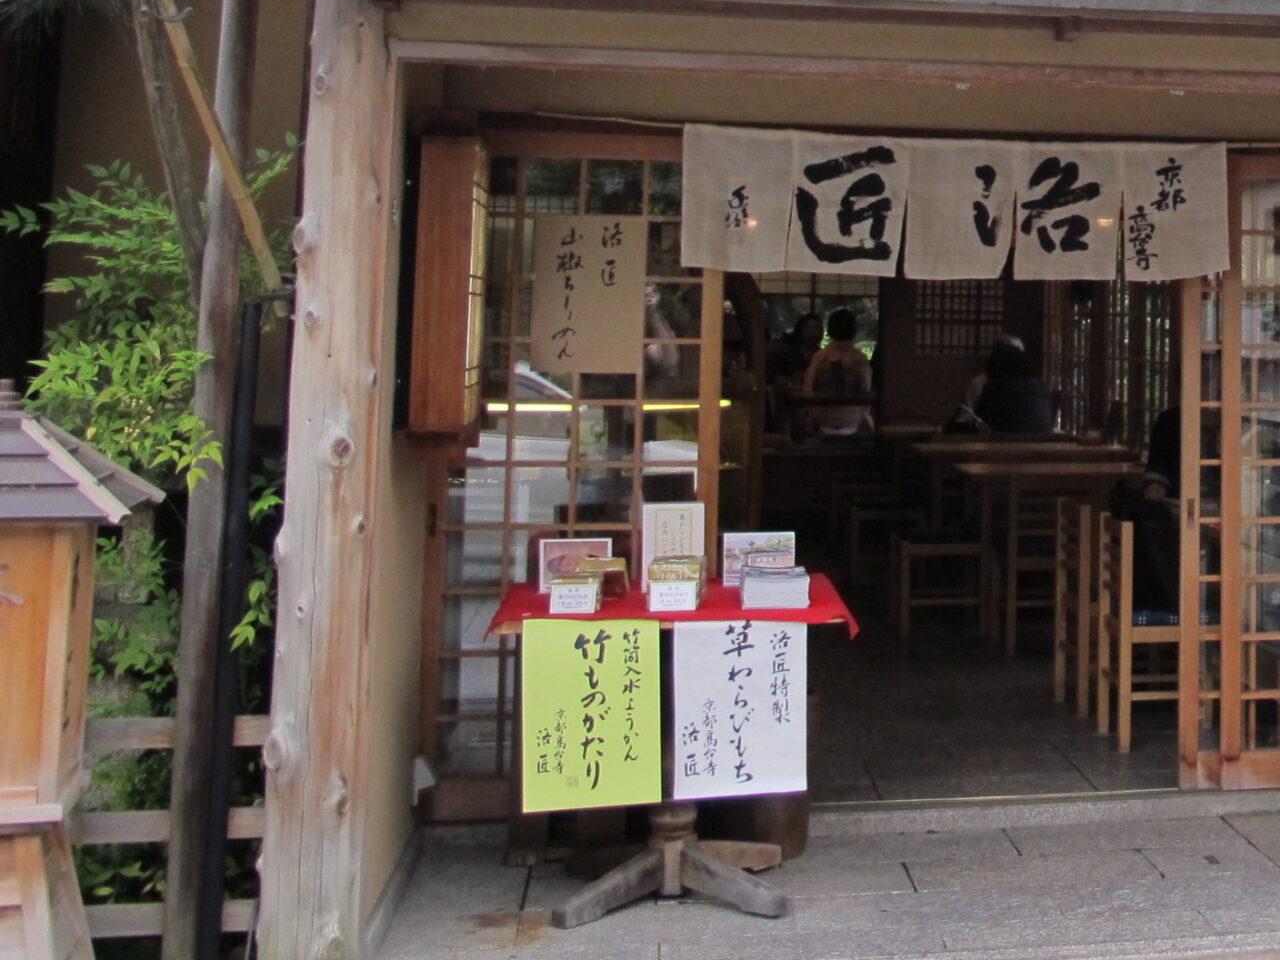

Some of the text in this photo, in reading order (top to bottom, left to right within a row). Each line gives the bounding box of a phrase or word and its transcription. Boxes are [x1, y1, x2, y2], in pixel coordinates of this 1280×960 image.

[1150, 157, 1186, 212] 京都
[601, 222, 624, 286] 洛匠
[573, 628, 613, 791] 竹ものがたり
[621, 628, 642, 762] 竹筒入水ようかん
[722, 620, 756, 784] 草わらびもち
[768, 629, 793, 725] 洛匠特製
[535, 727, 552, 775] 洛匠
[681, 721, 701, 778] 洛匠
